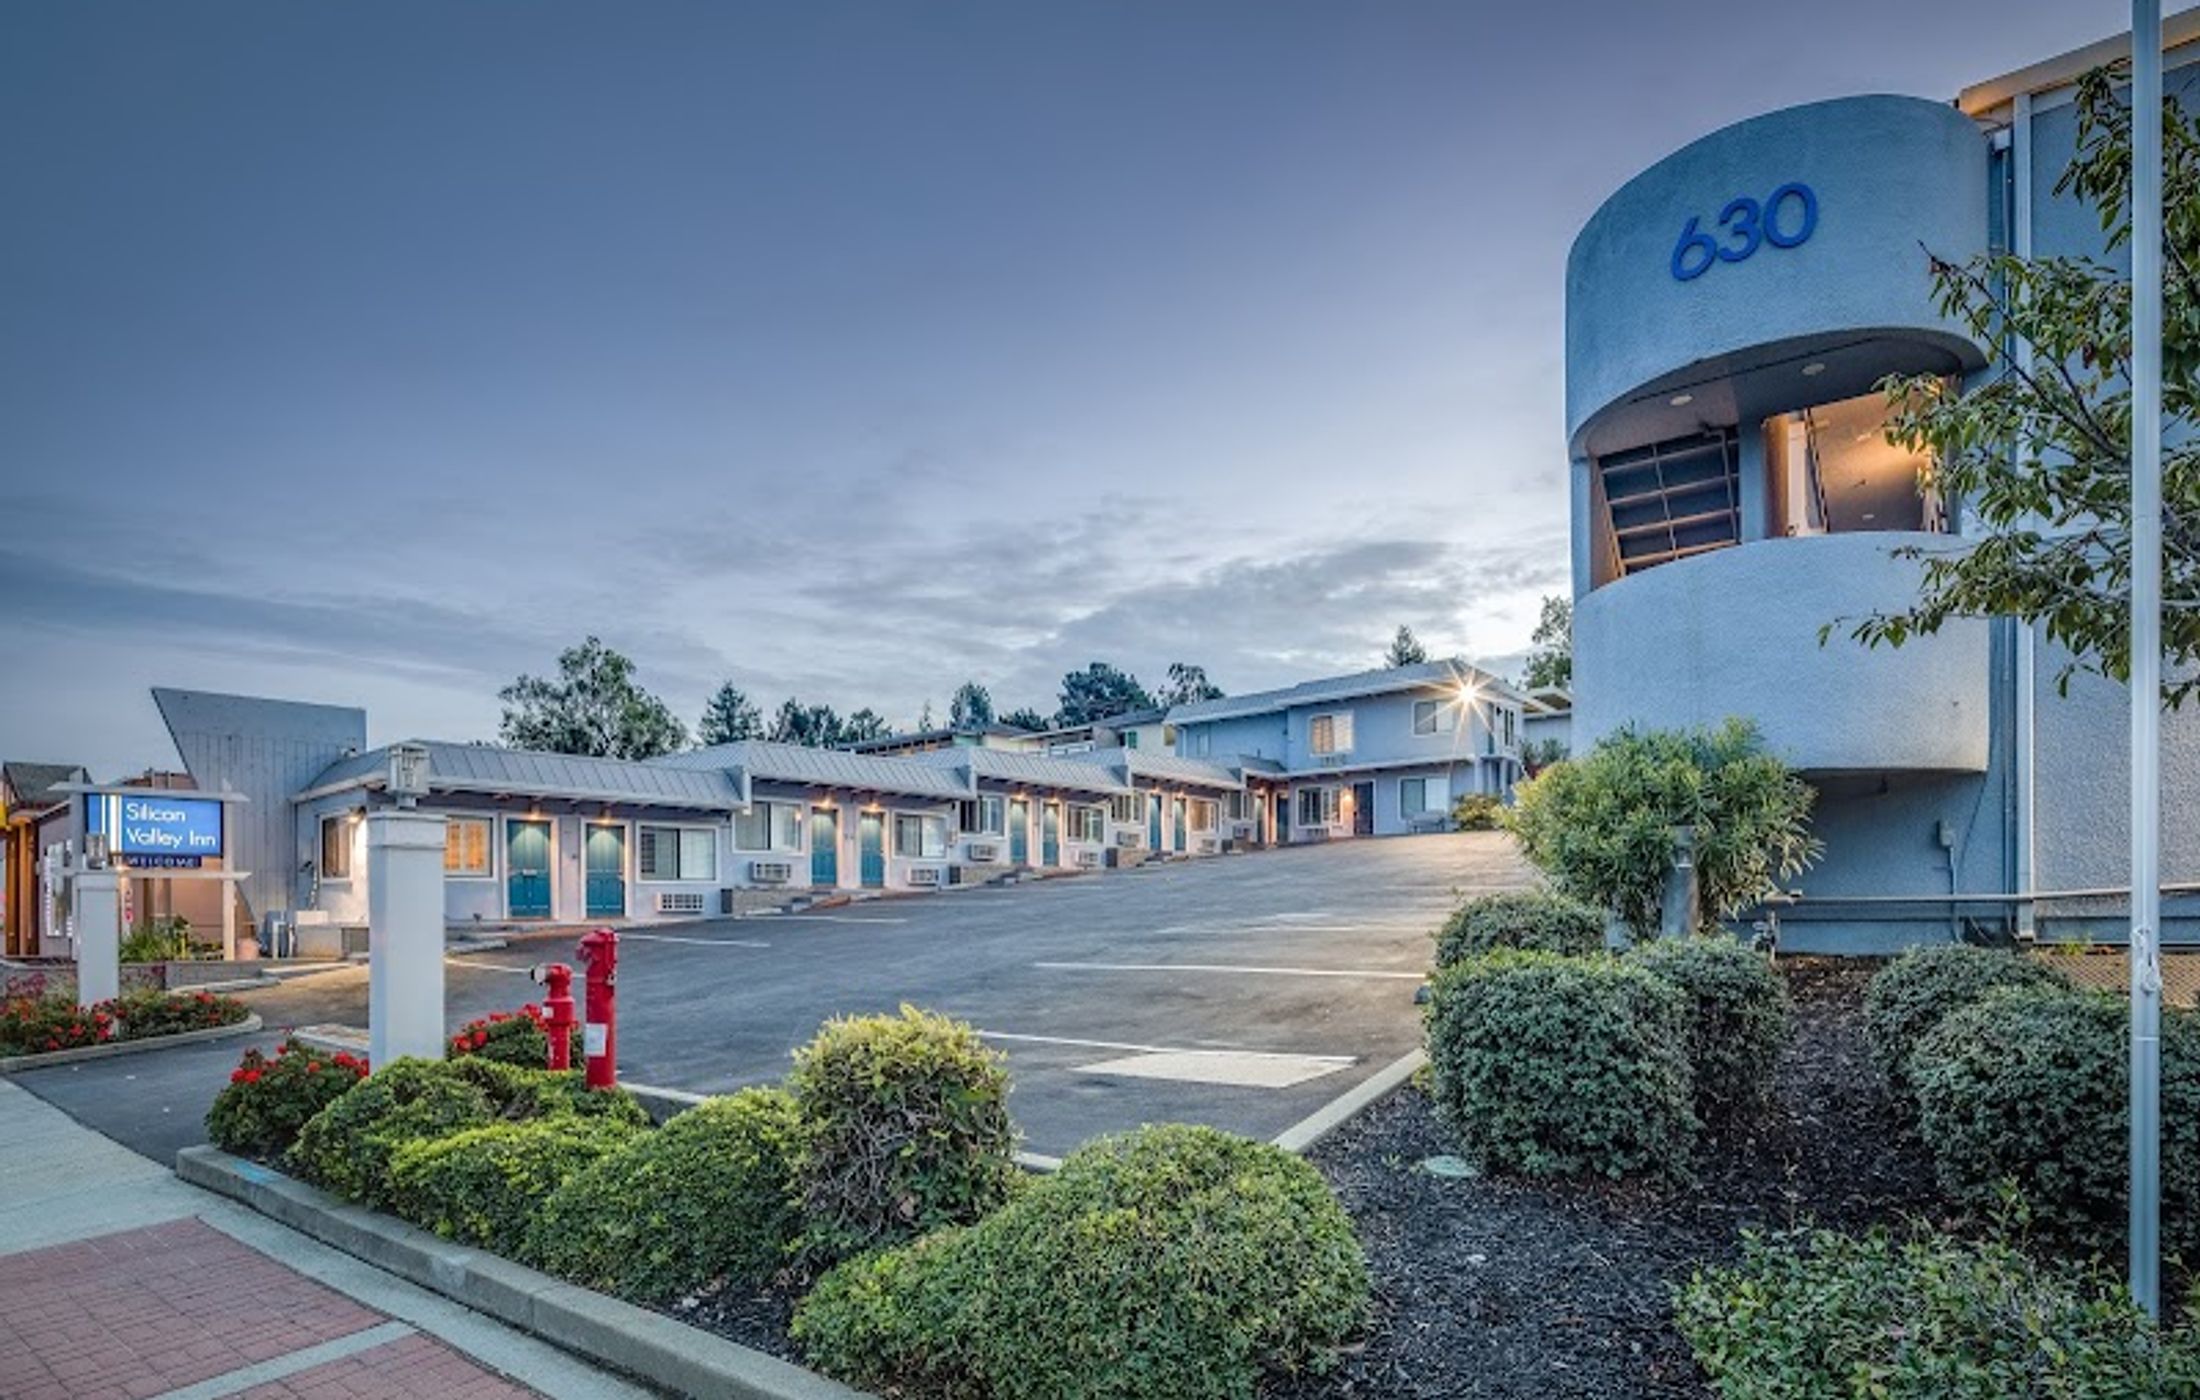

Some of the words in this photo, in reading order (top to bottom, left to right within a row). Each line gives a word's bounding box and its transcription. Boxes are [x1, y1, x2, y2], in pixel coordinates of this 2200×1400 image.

[1671, 182, 1818, 282] 630
[126, 803, 186, 822] Silicon
[127, 827, 182, 848] Valley
[190, 830, 216, 846] Inn
[128, 856, 195, 867] WELCOME
